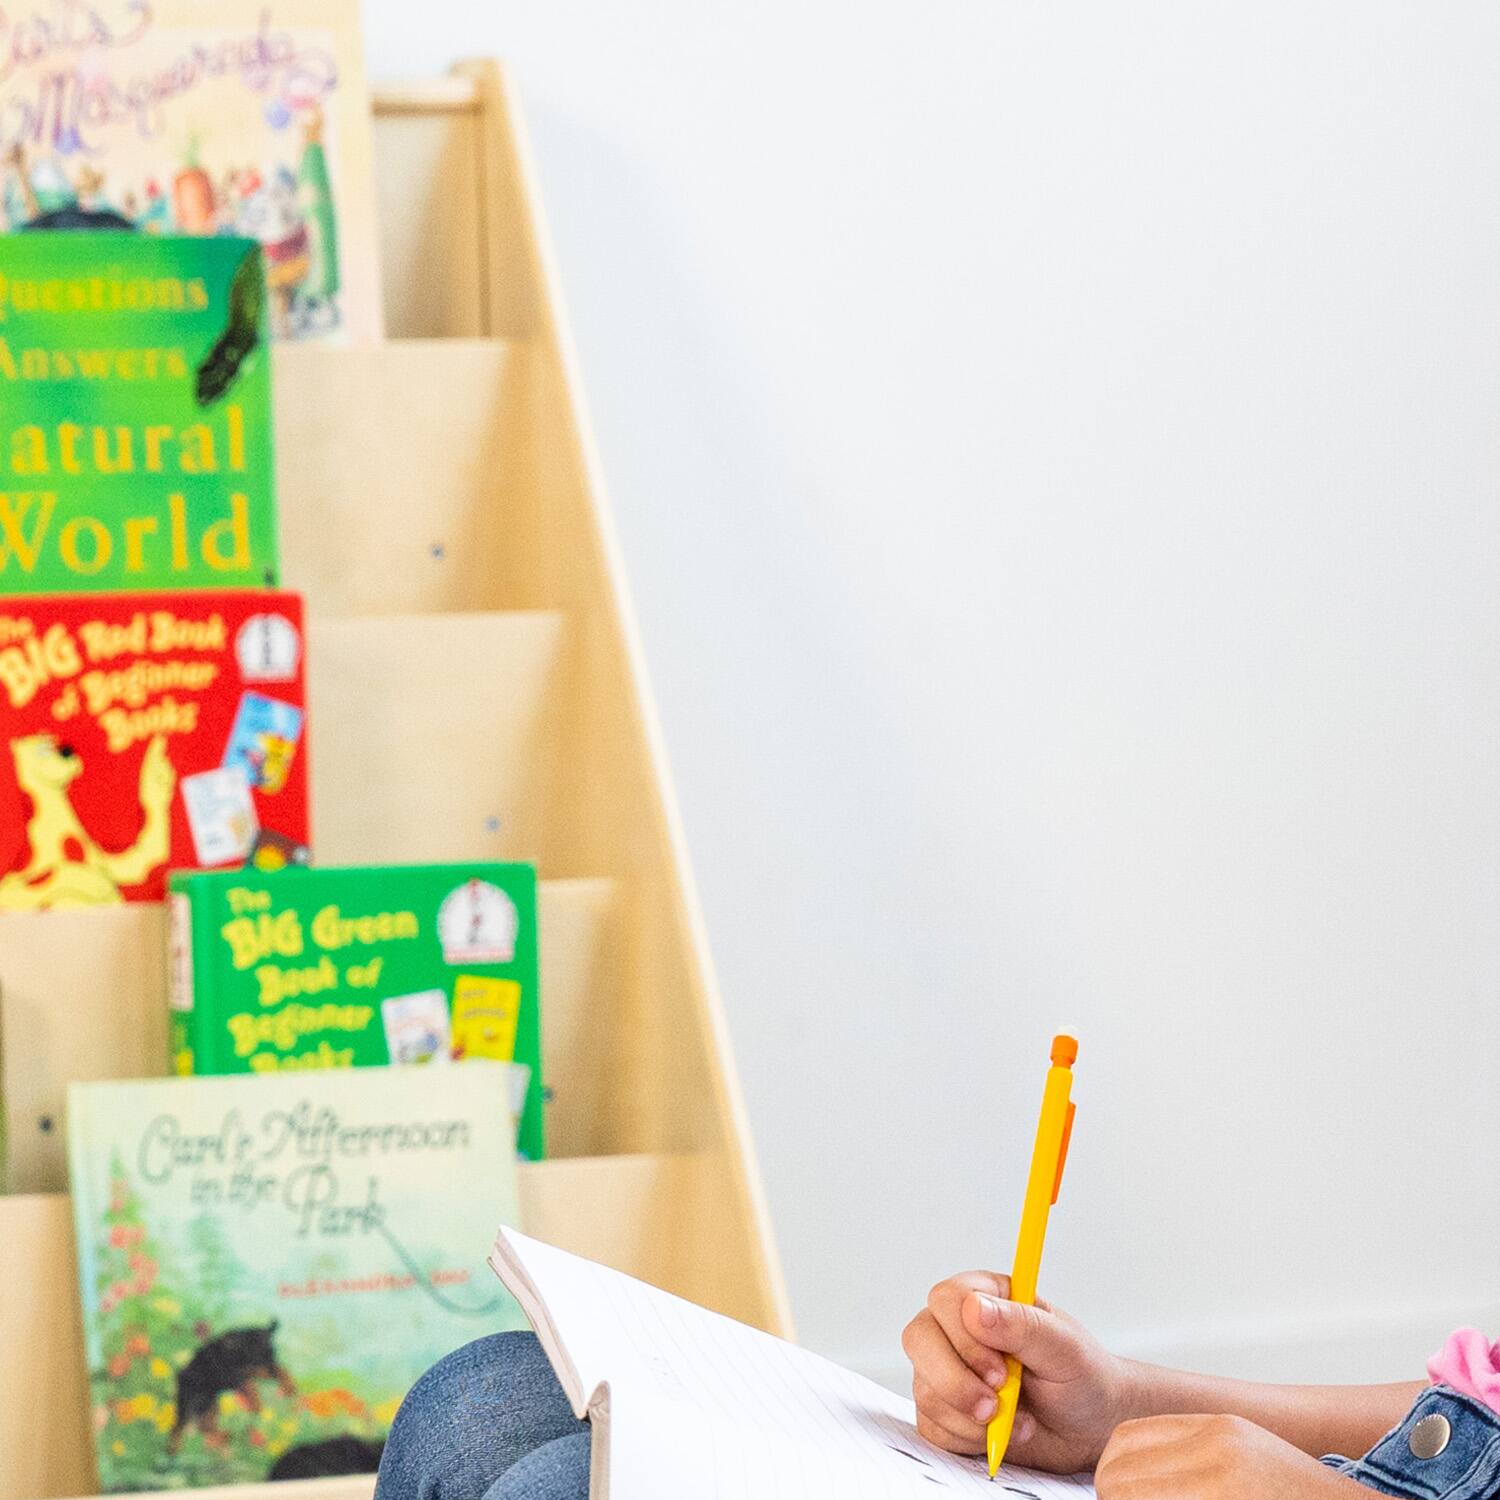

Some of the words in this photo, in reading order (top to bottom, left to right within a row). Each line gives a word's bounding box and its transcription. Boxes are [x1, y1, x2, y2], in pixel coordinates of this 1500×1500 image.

[0, 271, 209, 322] uestions
[10, 403, 245, 475] atural
[0, 491, 252, 574] World
[0, 622, 82, 708] BIG
[78, 611, 147, 662] Red
[151, 610, 226, 653] Book
[79, 660, 220, 716] Beginner
[99, 694, 200, 753] Books
[226, 887, 272, 914] The
[220, 908, 304, 970] BIG
[310, 904, 419, 950] Green
[254, 955, 338, 1007] Book
[345, 956, 384, 989] of
[226, 1002, 374, 1057] Beginner
[260, 1098, 471, 1164] Afternoon
[282, 1164, 387, 1240] Park
